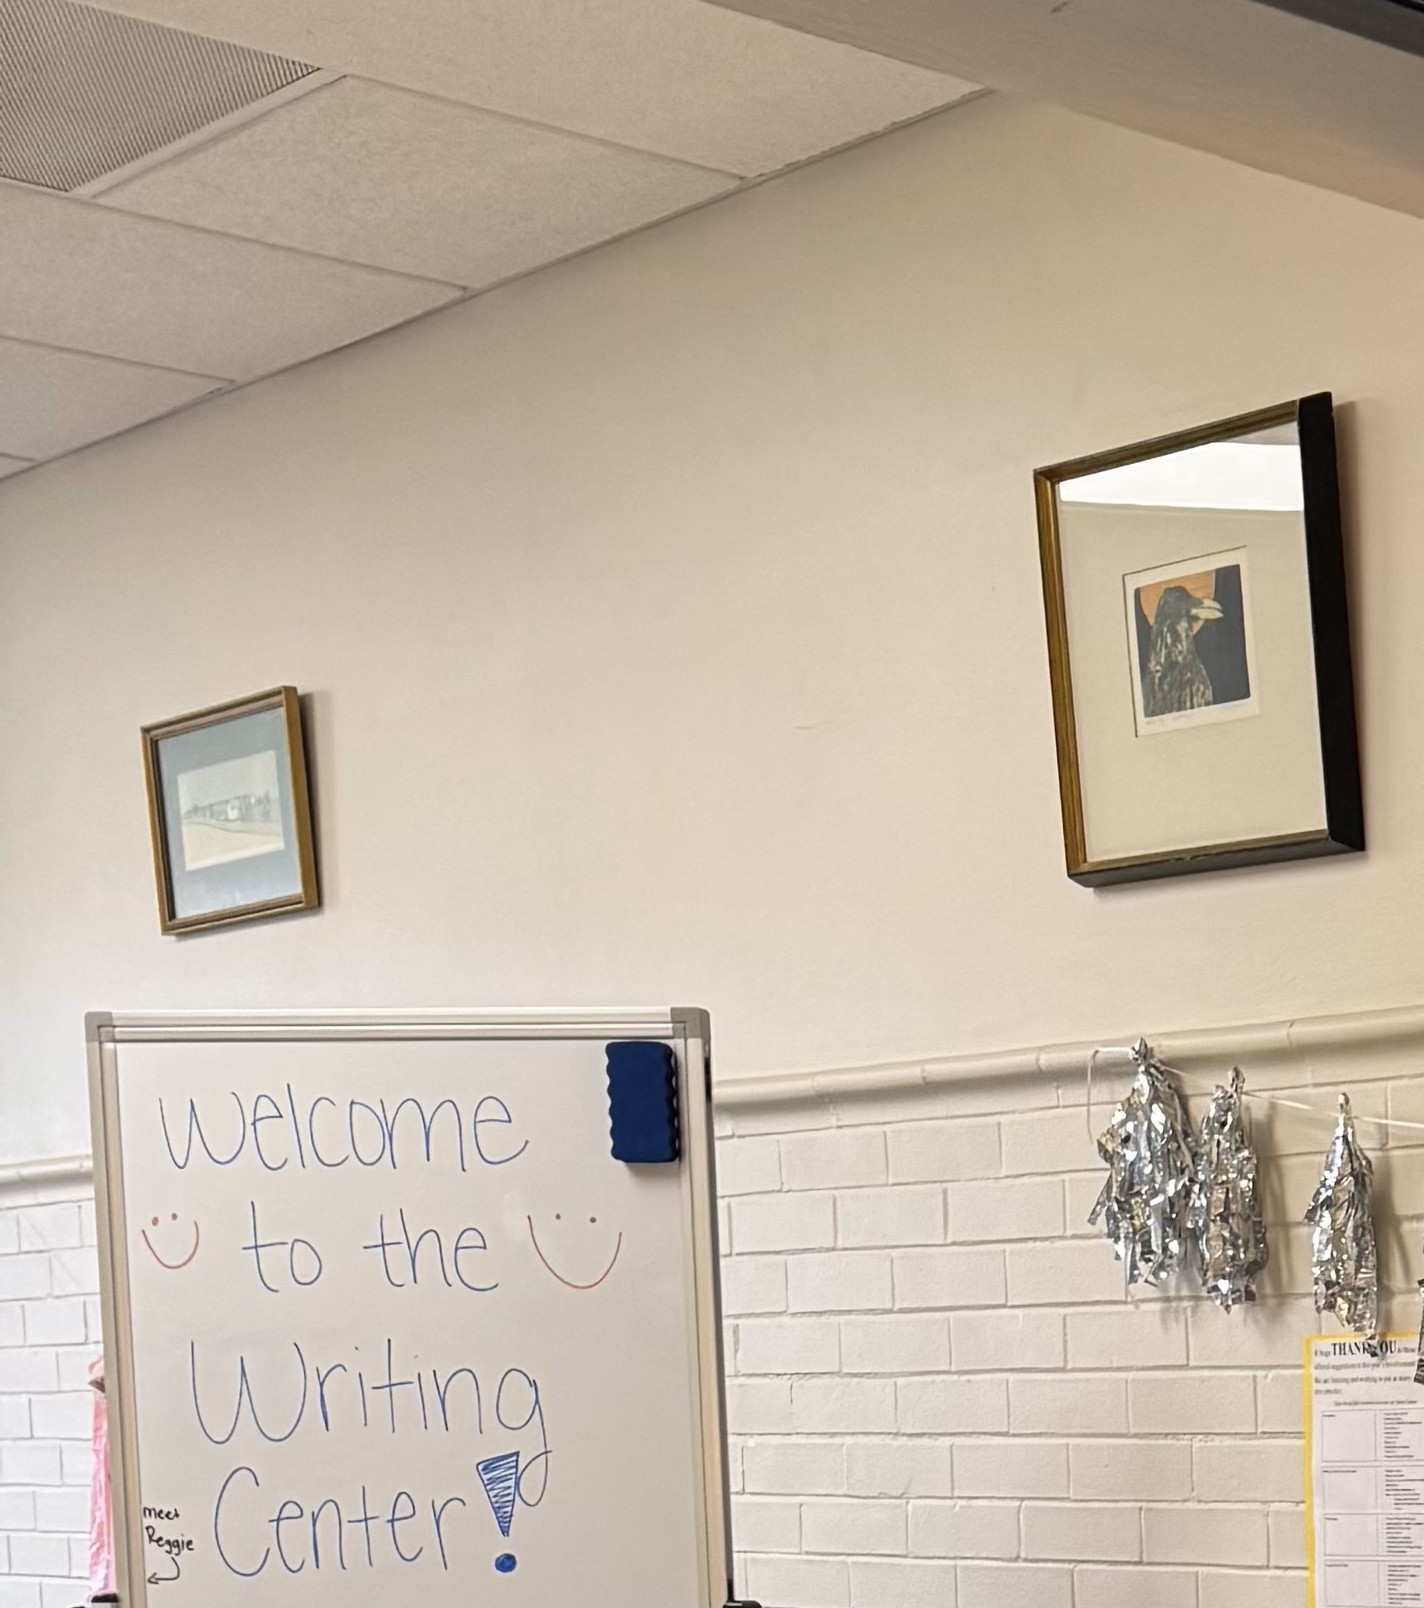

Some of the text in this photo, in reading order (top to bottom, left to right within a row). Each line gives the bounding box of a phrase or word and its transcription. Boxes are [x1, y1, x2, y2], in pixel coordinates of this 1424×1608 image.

[159, 1084, 530, 1172] Welcome
[242, 1202, 500, 1292] to the
[190, 1337, 553, 1508] Writing
[147, 1524, 195, 1556] Reggie
